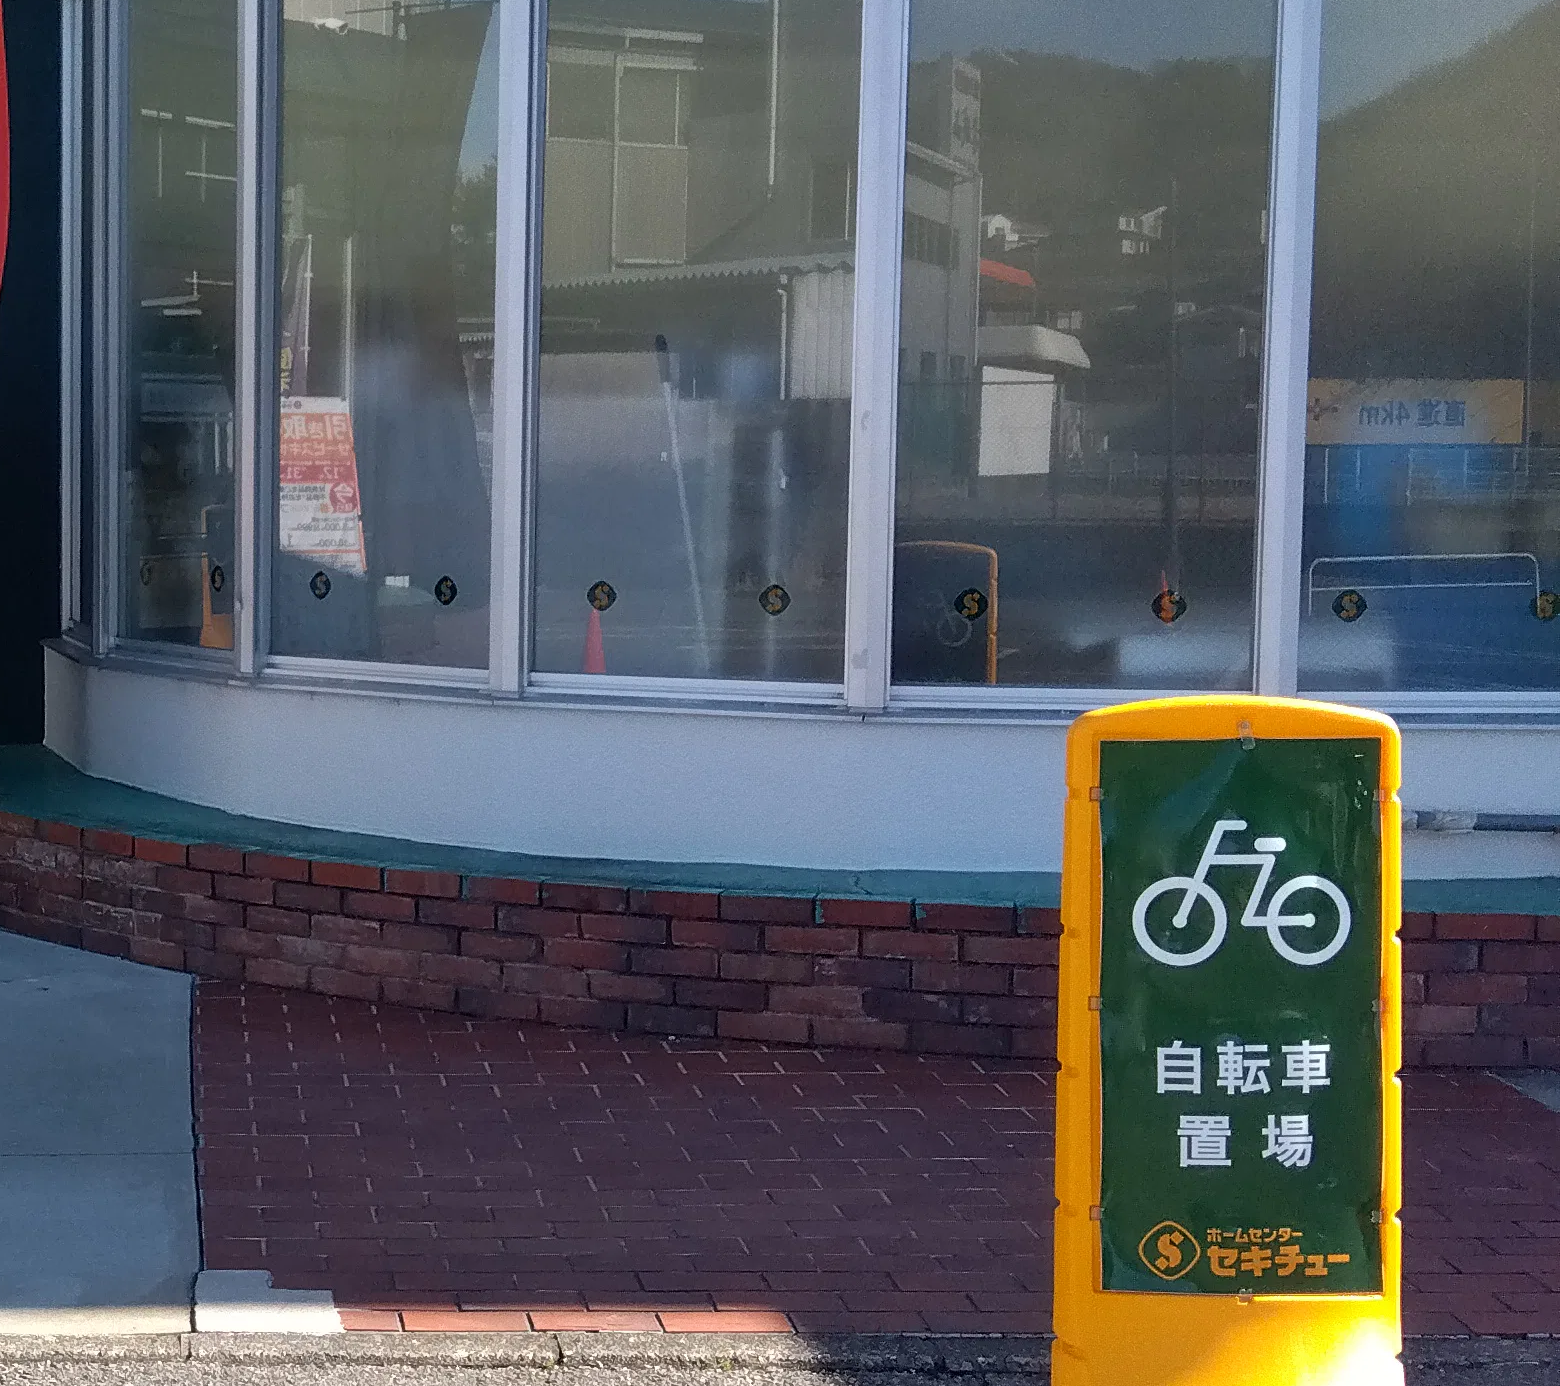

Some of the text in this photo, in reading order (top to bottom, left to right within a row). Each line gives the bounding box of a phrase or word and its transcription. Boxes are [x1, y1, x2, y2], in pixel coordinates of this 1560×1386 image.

[1155, 1040, 1332, 1095] 自転車
[1177, 1114, 1314, 1169] 置場
[1206, 1227, 1304, 1243] ホームセンター
[1206, 1244, 1351, 1277] セキチュー
